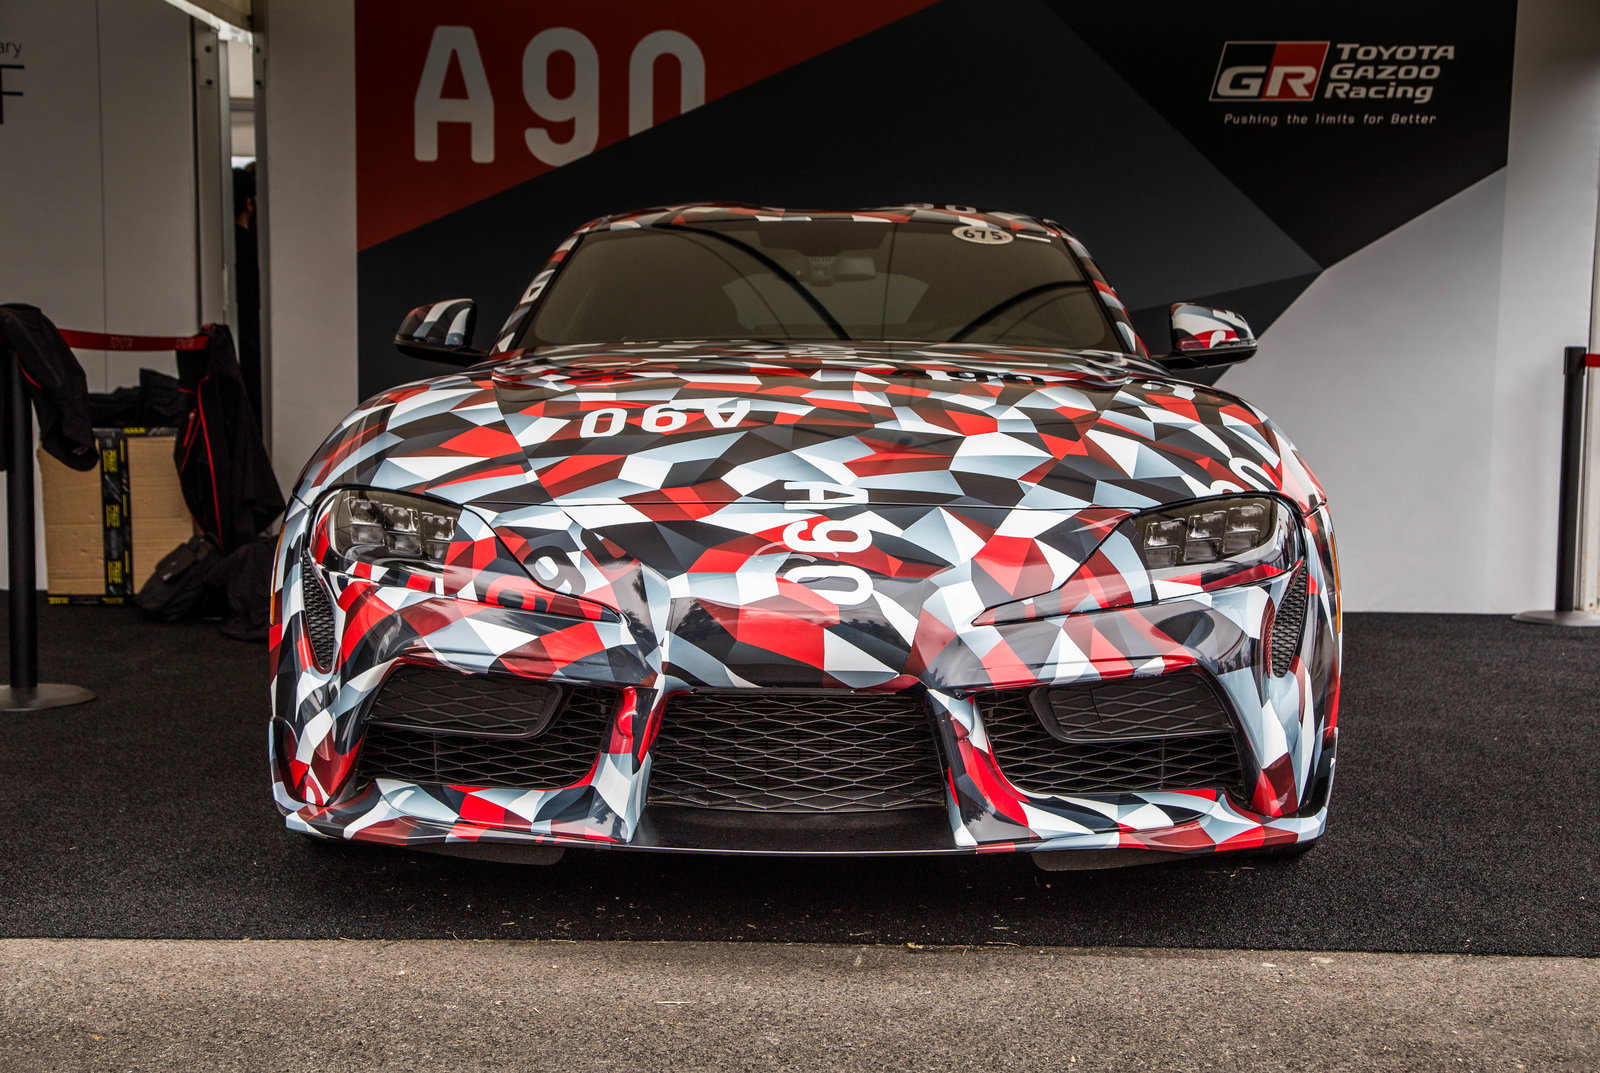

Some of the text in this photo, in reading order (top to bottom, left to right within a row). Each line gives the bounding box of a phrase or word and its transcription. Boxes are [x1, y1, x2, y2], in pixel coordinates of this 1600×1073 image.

[1336, 43, 1455, 61] TOYOTA
[1216, 65, 1317, 97] GR
[1329, 63, 1441, 80] GAZOO
[1324, 82, 1434, 104] Racing
[1224, 113, 1437, 127] Pushing the limits for Better
[962, 228, 1004, 241] 675
[579, 399, 751, 438] A90
[782, 481, 873, 606] A90
